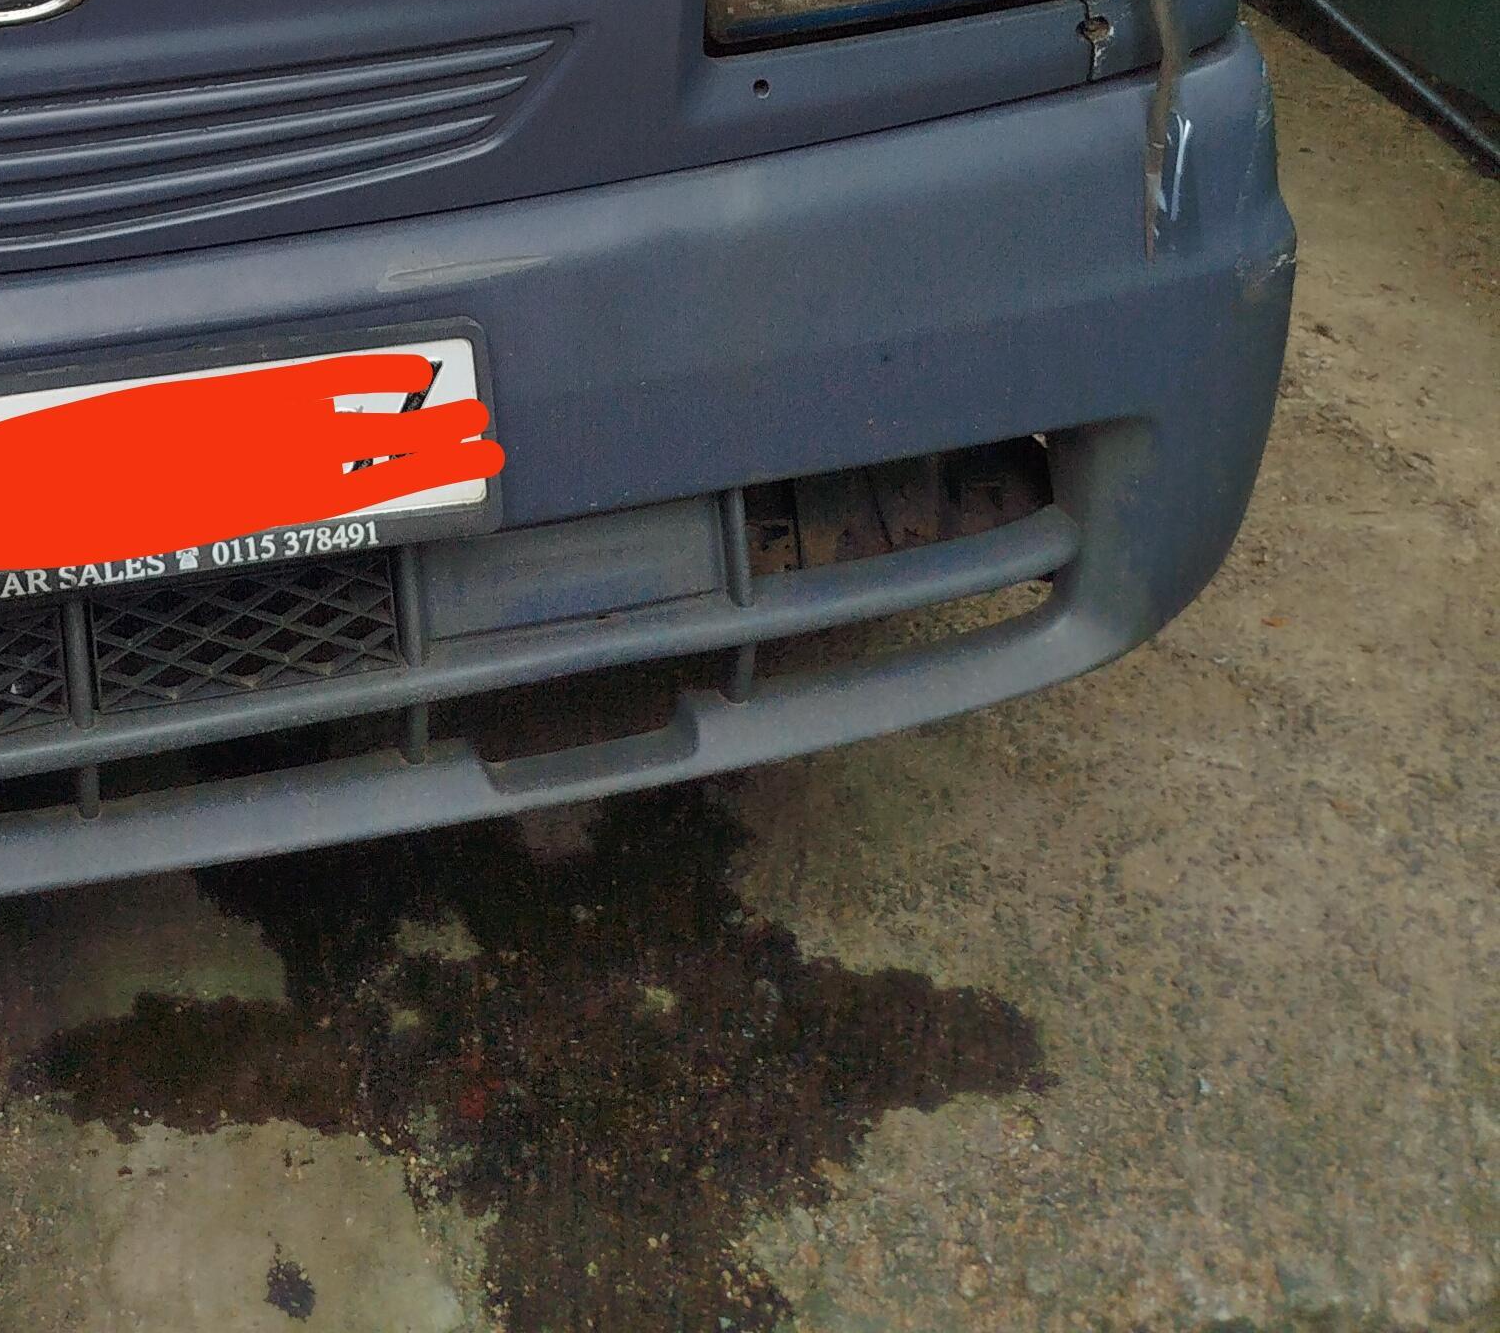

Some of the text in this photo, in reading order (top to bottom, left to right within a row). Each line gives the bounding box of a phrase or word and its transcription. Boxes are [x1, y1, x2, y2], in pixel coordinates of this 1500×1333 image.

[59, 553, 166, 587] SALES
[211, 533, 276, 566] 0115
[283, 521, 380, 557] 378491
